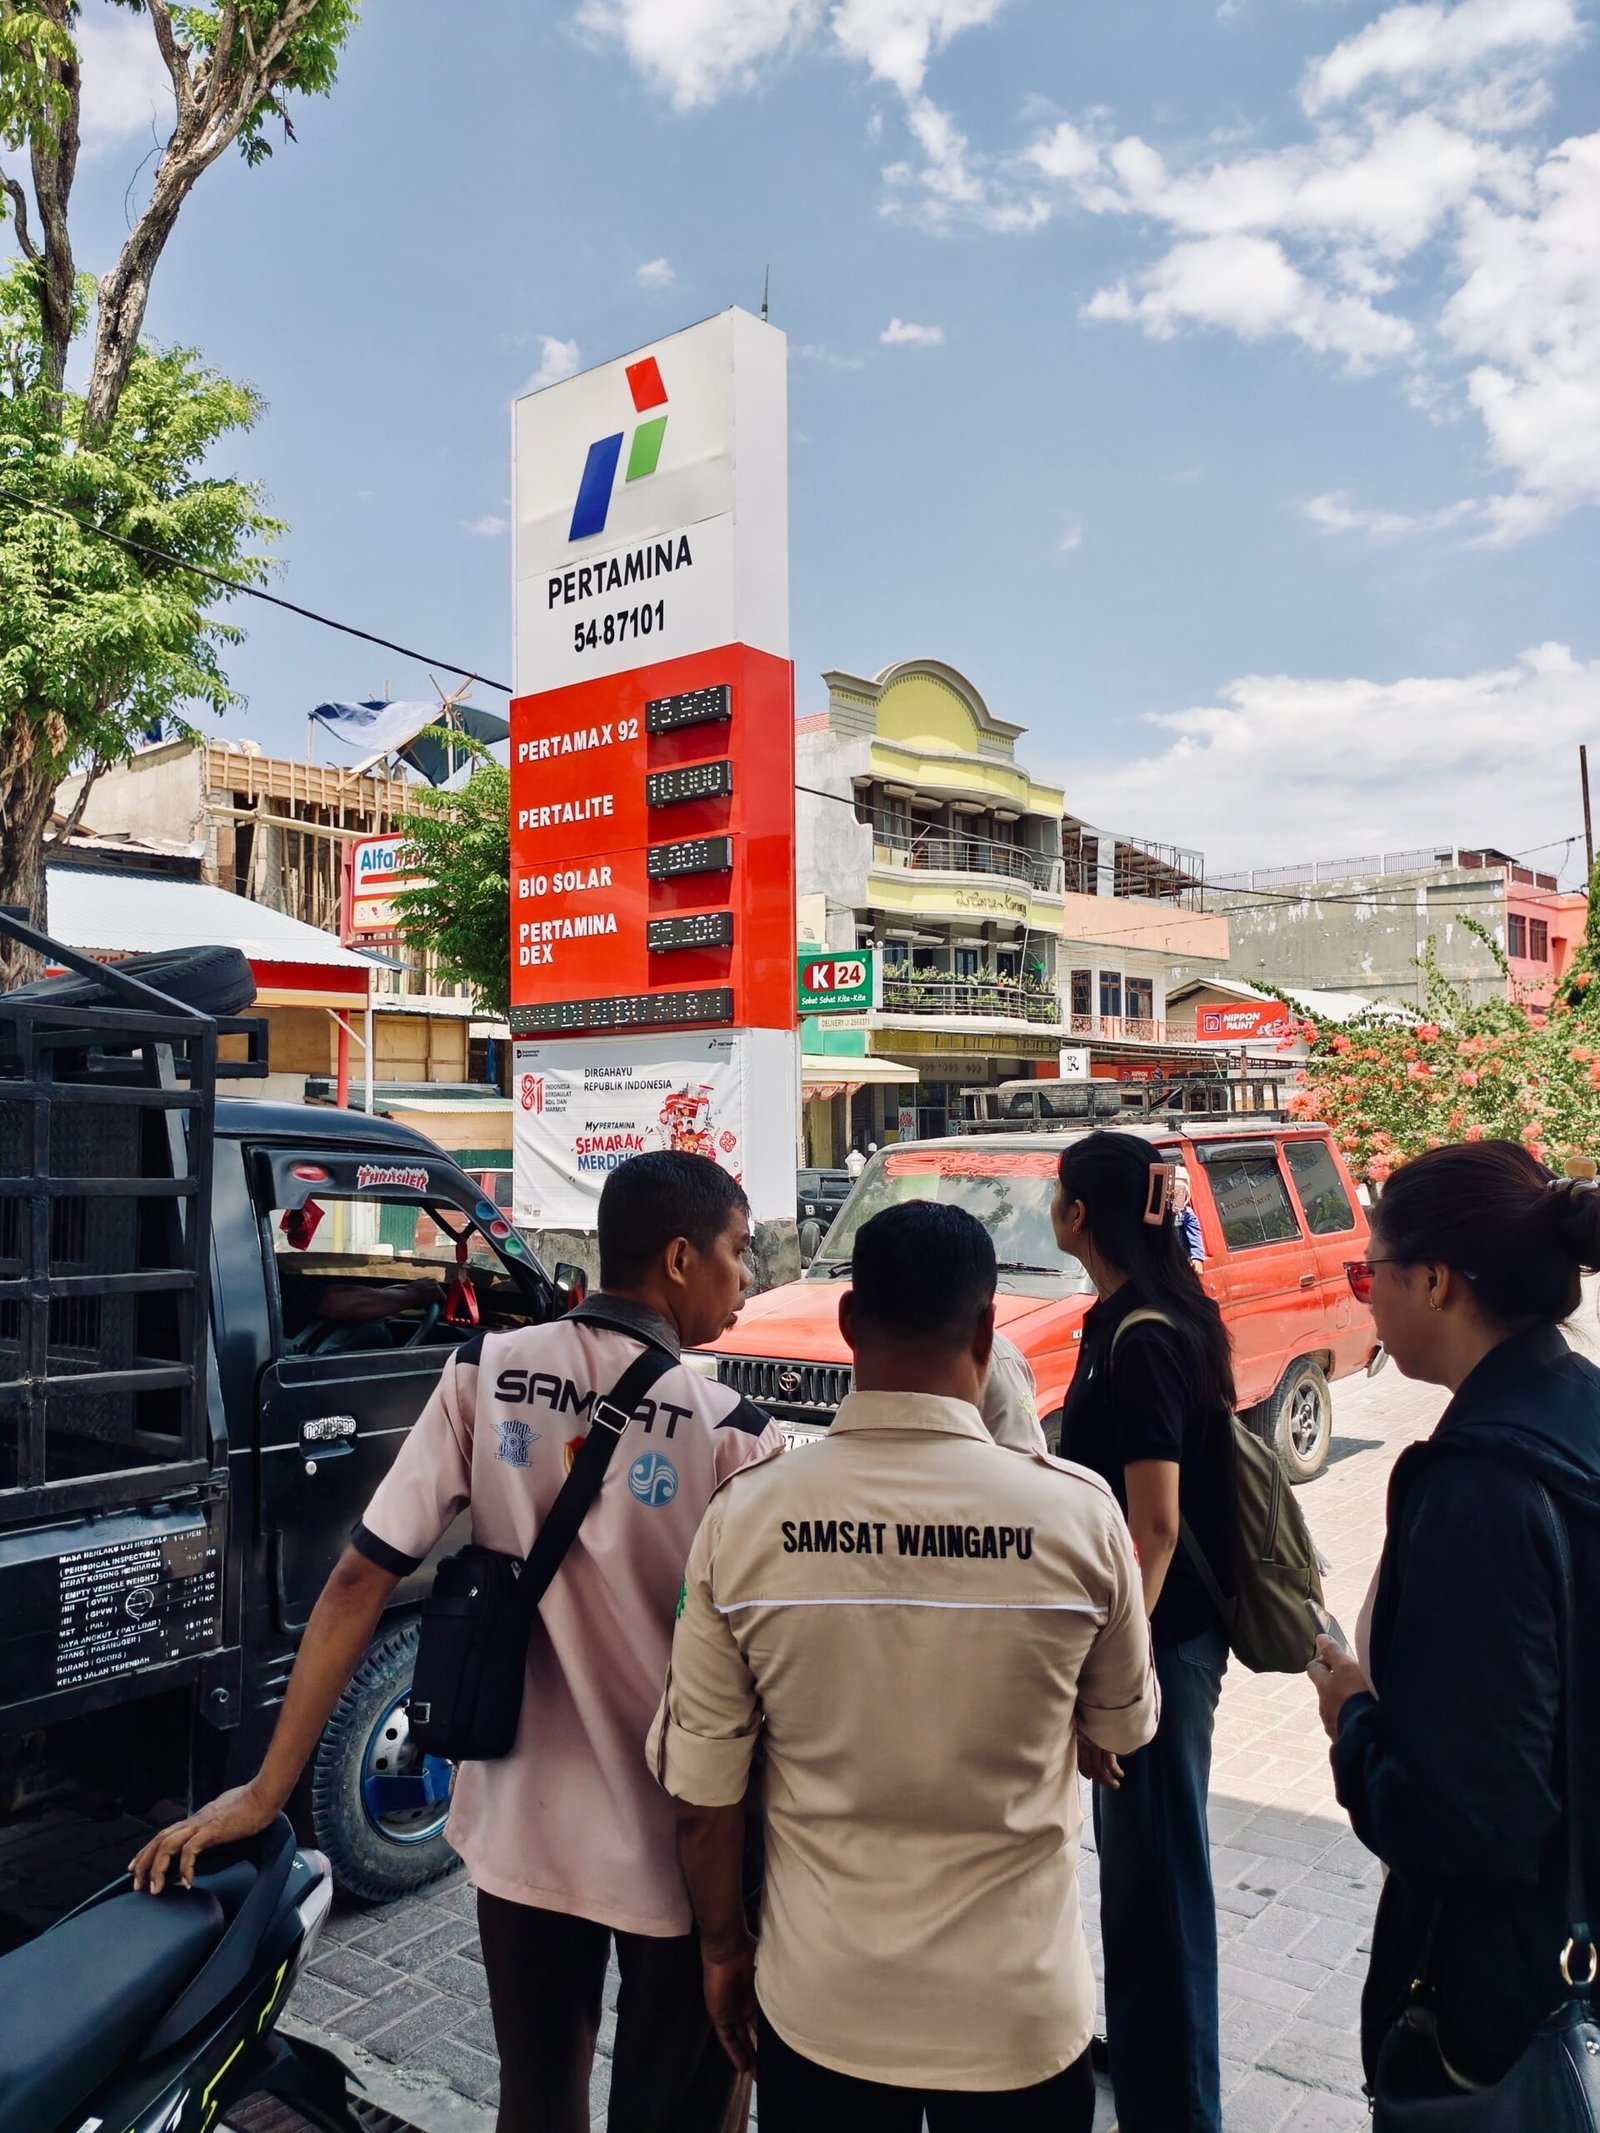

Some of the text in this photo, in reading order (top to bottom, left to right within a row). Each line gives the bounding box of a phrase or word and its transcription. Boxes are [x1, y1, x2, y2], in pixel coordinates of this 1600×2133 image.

[549, 534, 693, 610] PERTAMINA
[518, 718, 639, 764] PERTAMAX 92
[518, 794, 614, 831] PERTALITE
[519, 866, 612, 899] BIO SOLAR
[519, 912, 618, 943] PERTAMINA
[519, 943, 554, 967] DEX
[812, 964, 861, 989] K 24
[801, 993, 867, 1005] Sobat Sehat Kita-Kita
[1223, 1012, 1260, 1022] NIPPON
[1226, 1020, 1255, 1031] PAINT
[584, 1066, 633, 1078] DIRGAHAYU
[583, 1079, 673, 1092] REPUBLIK INDONESIA
[576, 1133, 646, 1155] SEMARAK
[577, 1153, 635, 1172] MERDE
[494, 1369, 694, 1439] SAMAT
[781, 1520, 1034, 1560] SAMSAT WAINGAPU
[59, 1553, 82, 1564] MASA
[120, 1543, 133, 1551] UJI
[59, 1577, 86, 1588] BERAT
[87, 1570, 120, 1583] KOSONG
[92, 1580, 125, 1593] VEHICLE
[80, 1630, 113, 1644] ANGKUT
[56, 1660, 90, 1674] BARANG
[56, 1674, 83, 1687] KELAS
[84, 1667, 109, 1680] JALAN
[111, 1656, 150, 1672] TERENDAH
